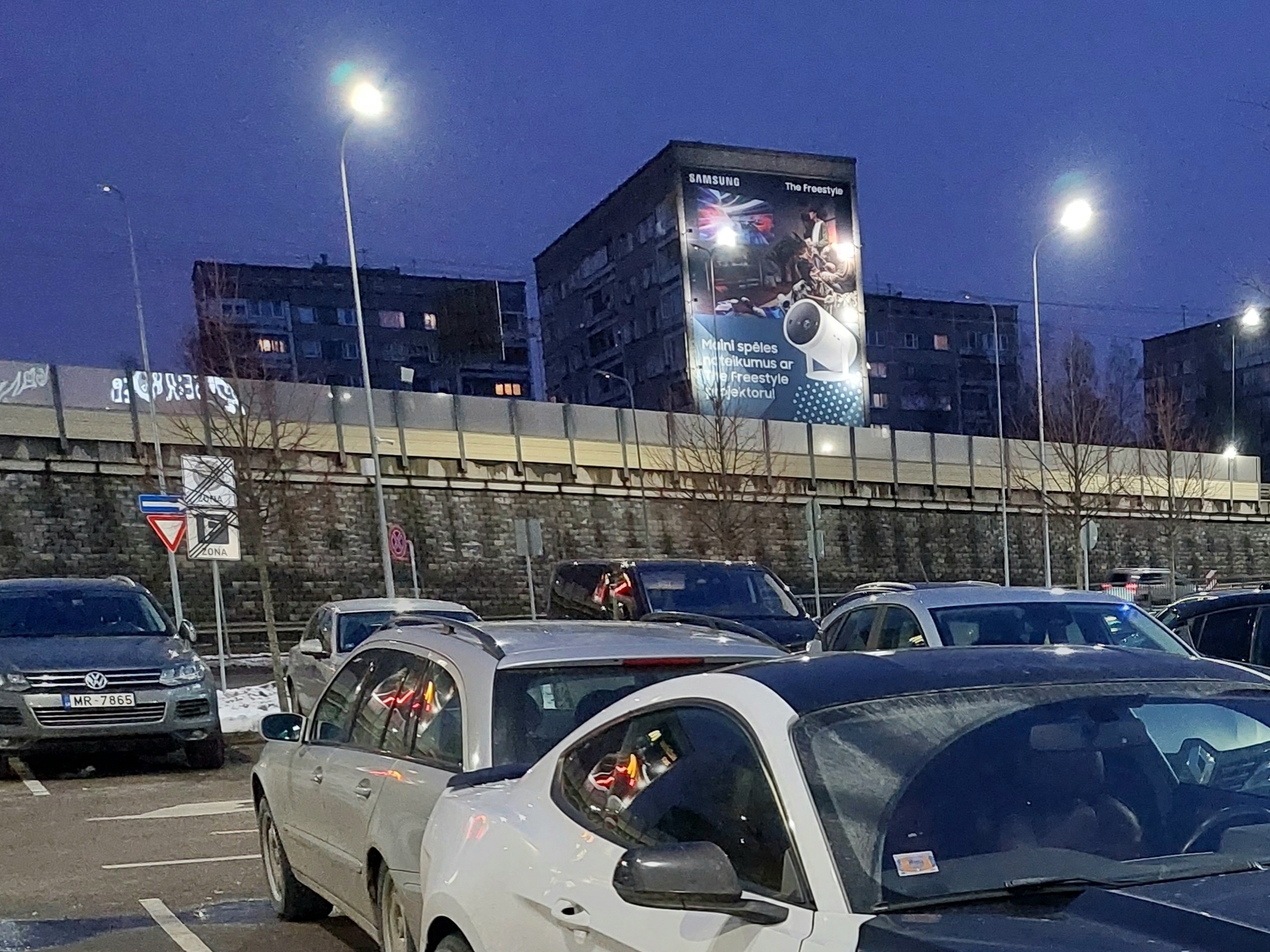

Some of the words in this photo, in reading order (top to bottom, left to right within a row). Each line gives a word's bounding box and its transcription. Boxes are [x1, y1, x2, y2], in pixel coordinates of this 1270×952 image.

[689, 173, 740, 187] SAMSUNG
[785, 182, 801, 191] The
[803, 183, 844, 197] Freestyle
[737, 341, 778, 356] spēles
[780, 360, 794, 370] ar
[730, 371, 789, 387] Freestyle
[202, 546, 228, 557] ZONA
[74, 694, 133, 706] MR-7865
